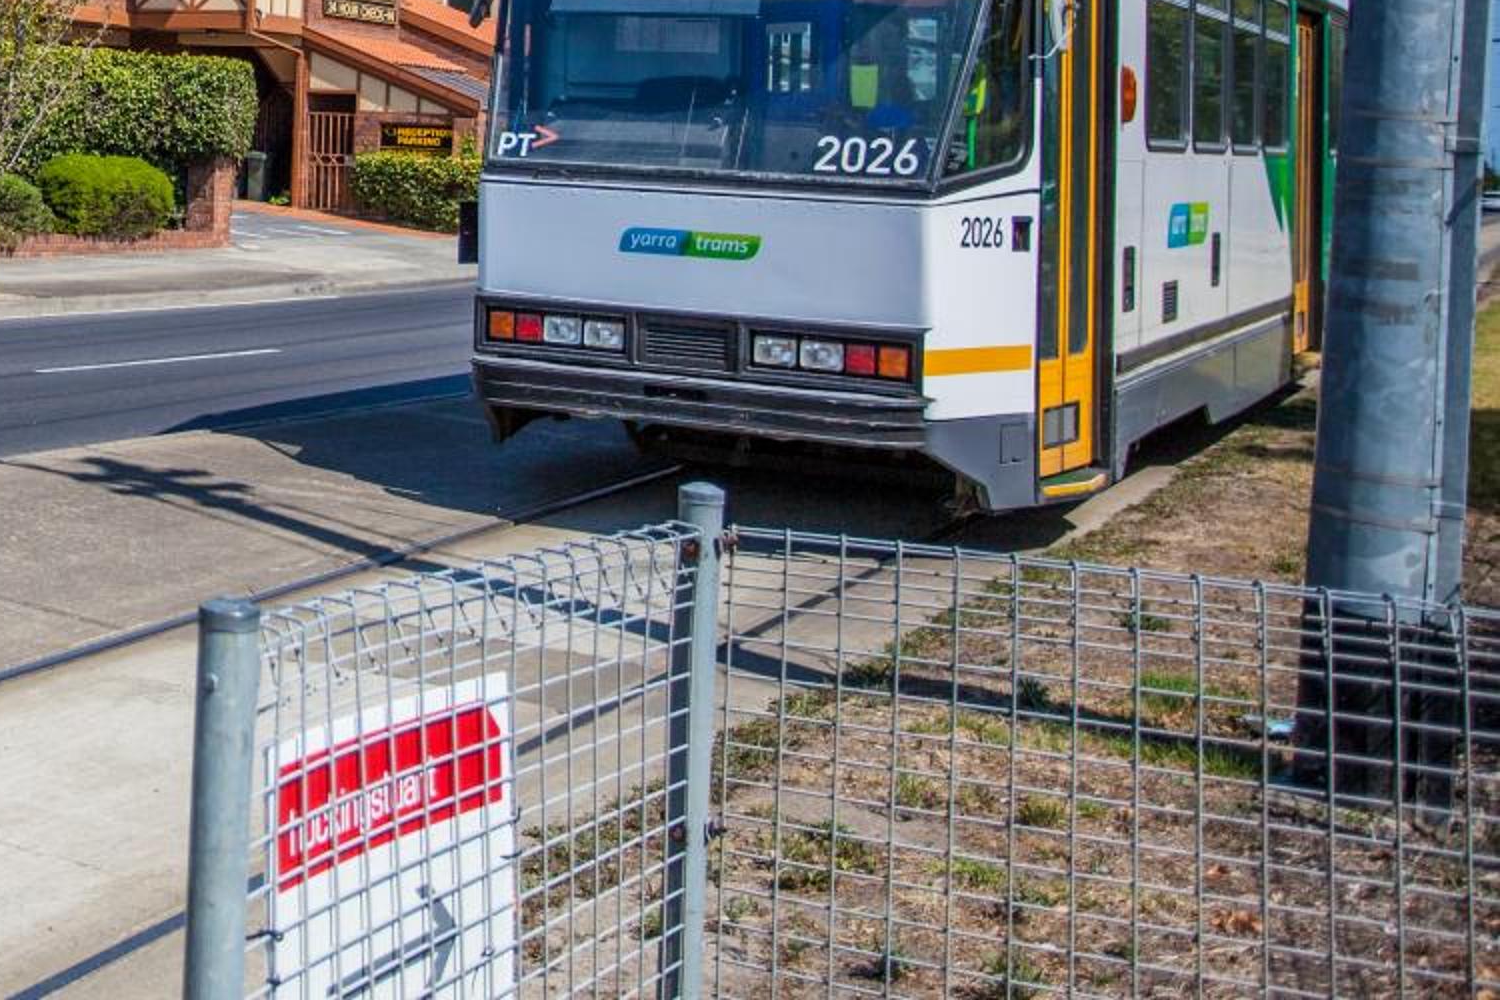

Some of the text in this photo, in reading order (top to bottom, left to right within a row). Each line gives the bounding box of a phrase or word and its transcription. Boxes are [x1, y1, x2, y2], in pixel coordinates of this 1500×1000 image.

[812, 135, 920, 176] 2026
[629, 232, 750, 254] yarra trams
[960, 216, 1004, 250] 2026
